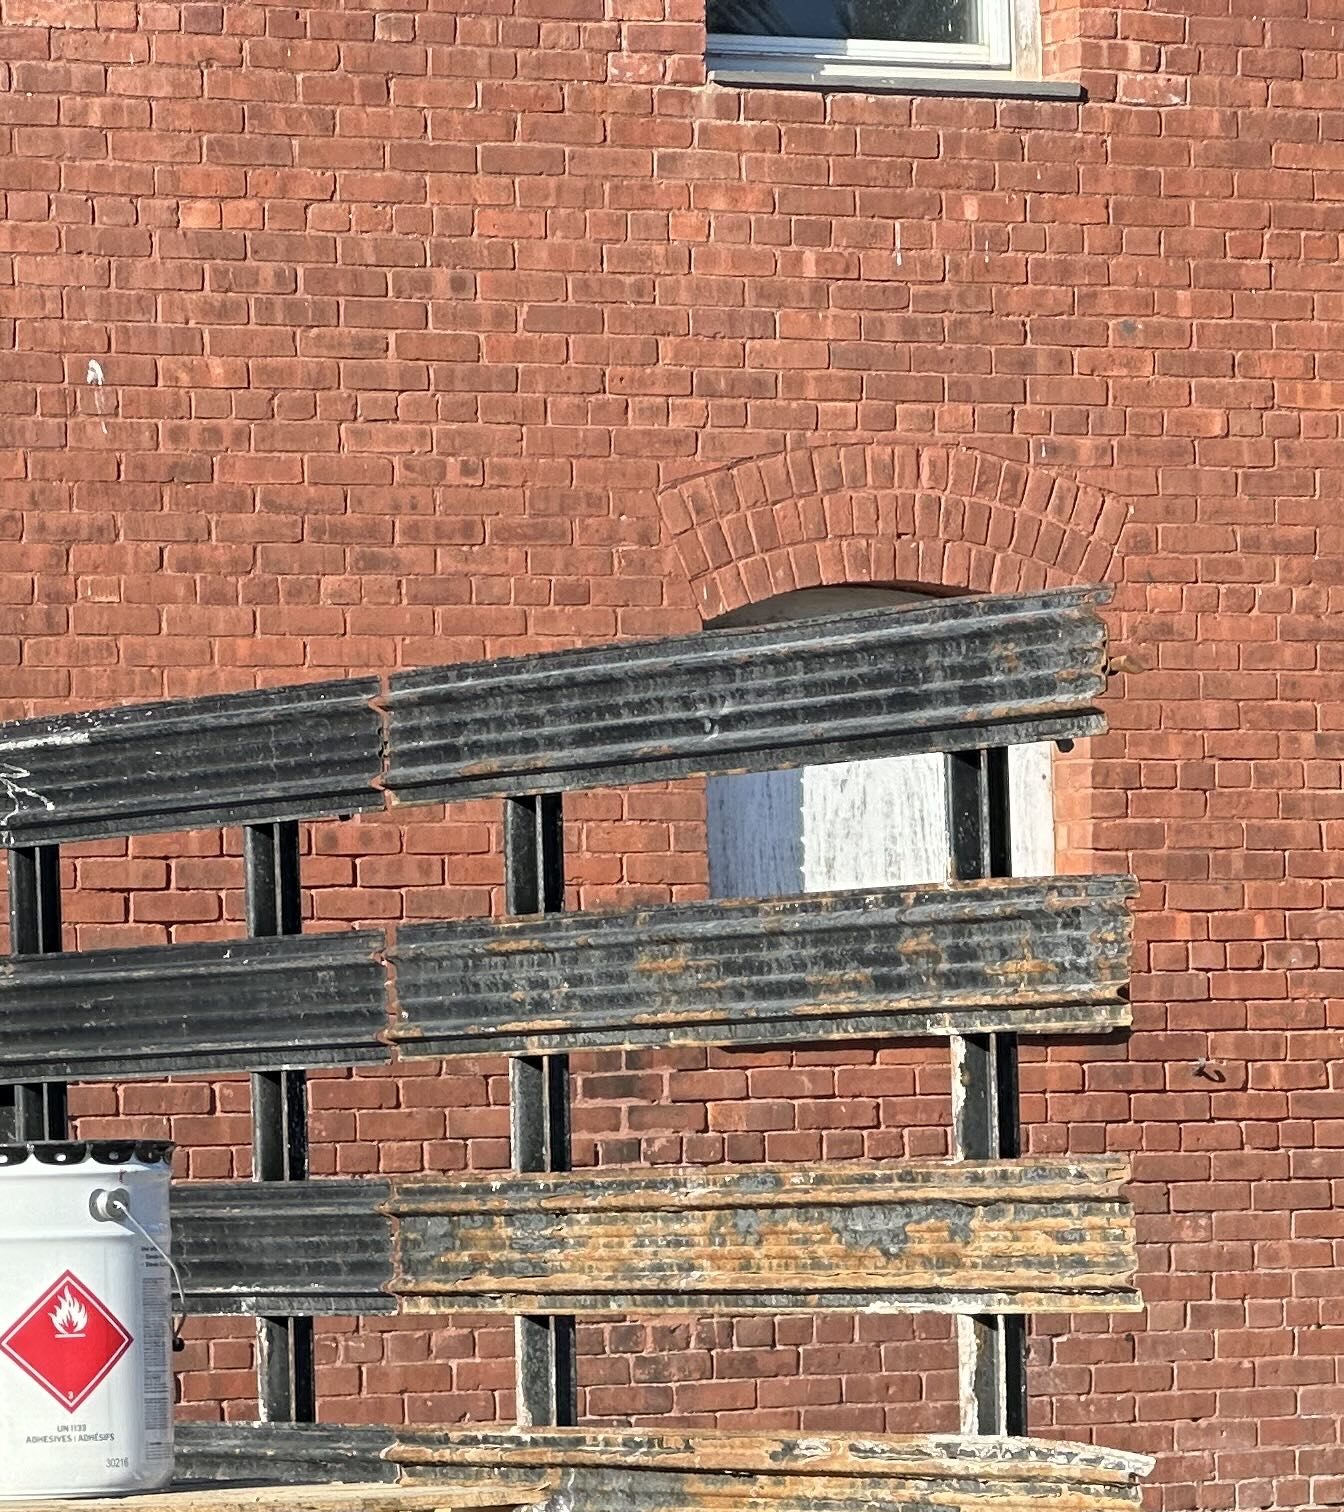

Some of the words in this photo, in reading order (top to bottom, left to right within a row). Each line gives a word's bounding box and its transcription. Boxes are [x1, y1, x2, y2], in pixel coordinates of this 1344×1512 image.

[67, 1390, 75, 1400] 3
[57, 1424, 69, 1433] UN
[25, 1434, 73, 1444] ADHESIVES
[105, 1457, 129, 1468] 30216
